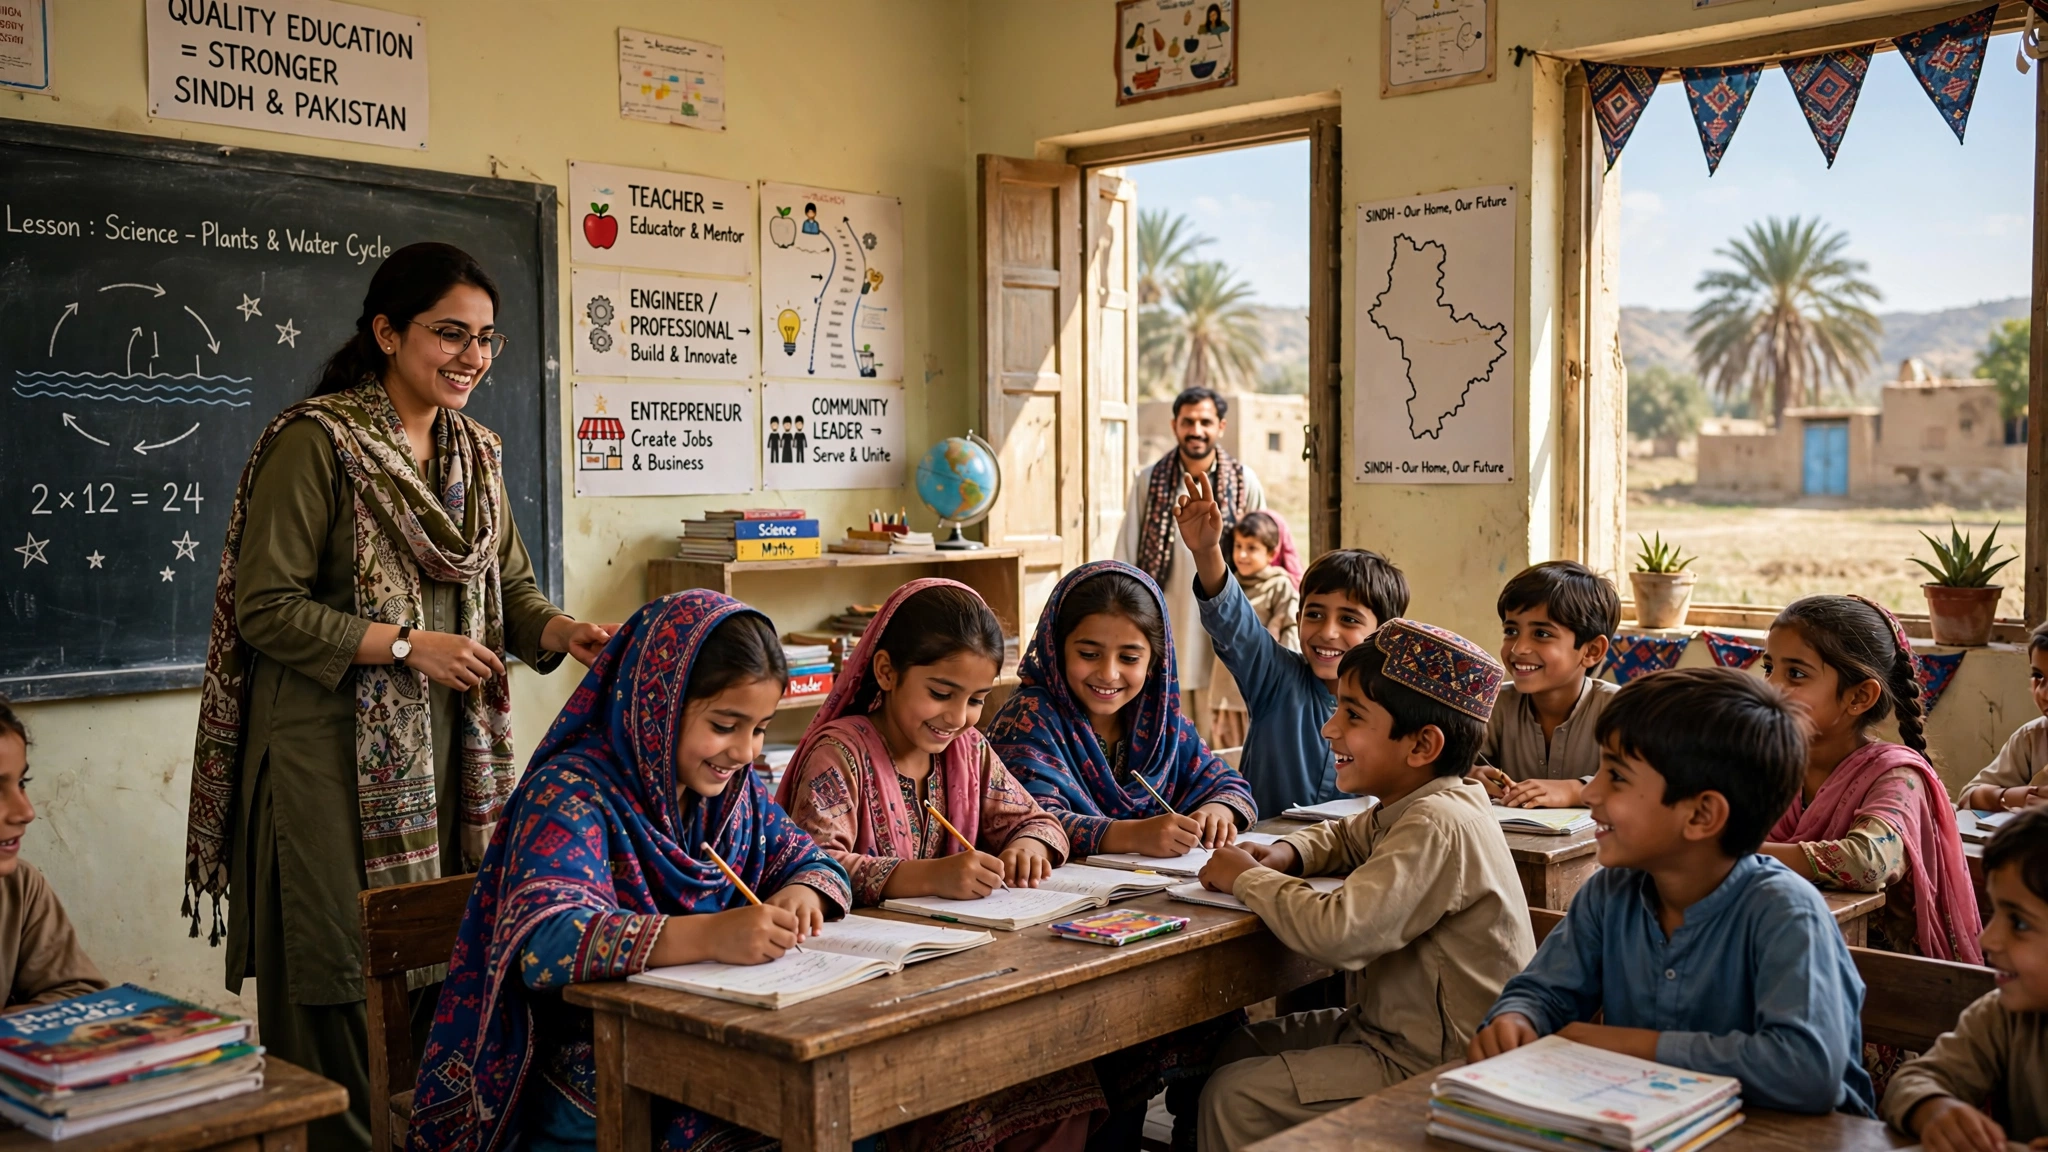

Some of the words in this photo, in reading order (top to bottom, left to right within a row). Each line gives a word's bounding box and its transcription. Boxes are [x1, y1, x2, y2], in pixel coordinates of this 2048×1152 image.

[168, 0, 277, 37] QUALITY
[286, 13, 413, 61] EDUCATION
[181, 43, 198, 58] =
[208, 40, 339, 87] STRONGER
[173, 75, 254, 112] SINDH
[266, 88, 285, 116] &
[295, 91, 407, 132] PAKISTAN
[628, 184, 706, 215] TEACHER
[711, 200, 725, 211] =
[1365, 206, 1396, 224] SINDH
[1403, 204, 1422, 219] Our
[1423, 201, 1453, 217] Home,
[1454, 198, 1474, 212] Our
[1475, 195, 1508, 211] Future
[6, 203, 81, 238] Lesson
[105, 213, 179, 245] Science
[201, 220, 259, 250] Plants
[266, 228, 280, 252] &
[285, 228, 340, 255] Water
[346, 232, 392, 266] Cycle
[630, 215, 687, 239] Educator
[689, 221, 700, 240] &
[703, 222, 746, 245] Mentor
[630, 288, 704, 314] ENGINEER
[630, 314, 735, 341] PROFESSIONAL
[630, 342, 665, 363] Build
[669, 344, 680, 363] &
[683, 345, 738, 367] Innovate
[630, 400, 743, 424] ENTREPRENEUR
[811, 396, 890, 418] COMMUNITY
[630, 427, 678, 448] Create
[682, 429, 714, 449] Jobs
[812, 421, 864, 441] LEADER
[631, 452, 643, 473] &
[647, 453, 705, 472] Business
[812, 445, 847, 464] Serve
[849, 446, 858, 463] &
[861, 446, 891, 464] Unite
[1363, 460, 1394, 475] SINDH
[1401, 460, 1420, 474] Our
[1421, 460, 1450, 476] Home,
[1451, 459, 1471, 474] Our
[1472, 459, 1505, 474] Future
[162, 481, 205, 515] 24
[758, 523, 797, 537] Science
[790, 675, 823, 695] Reader
